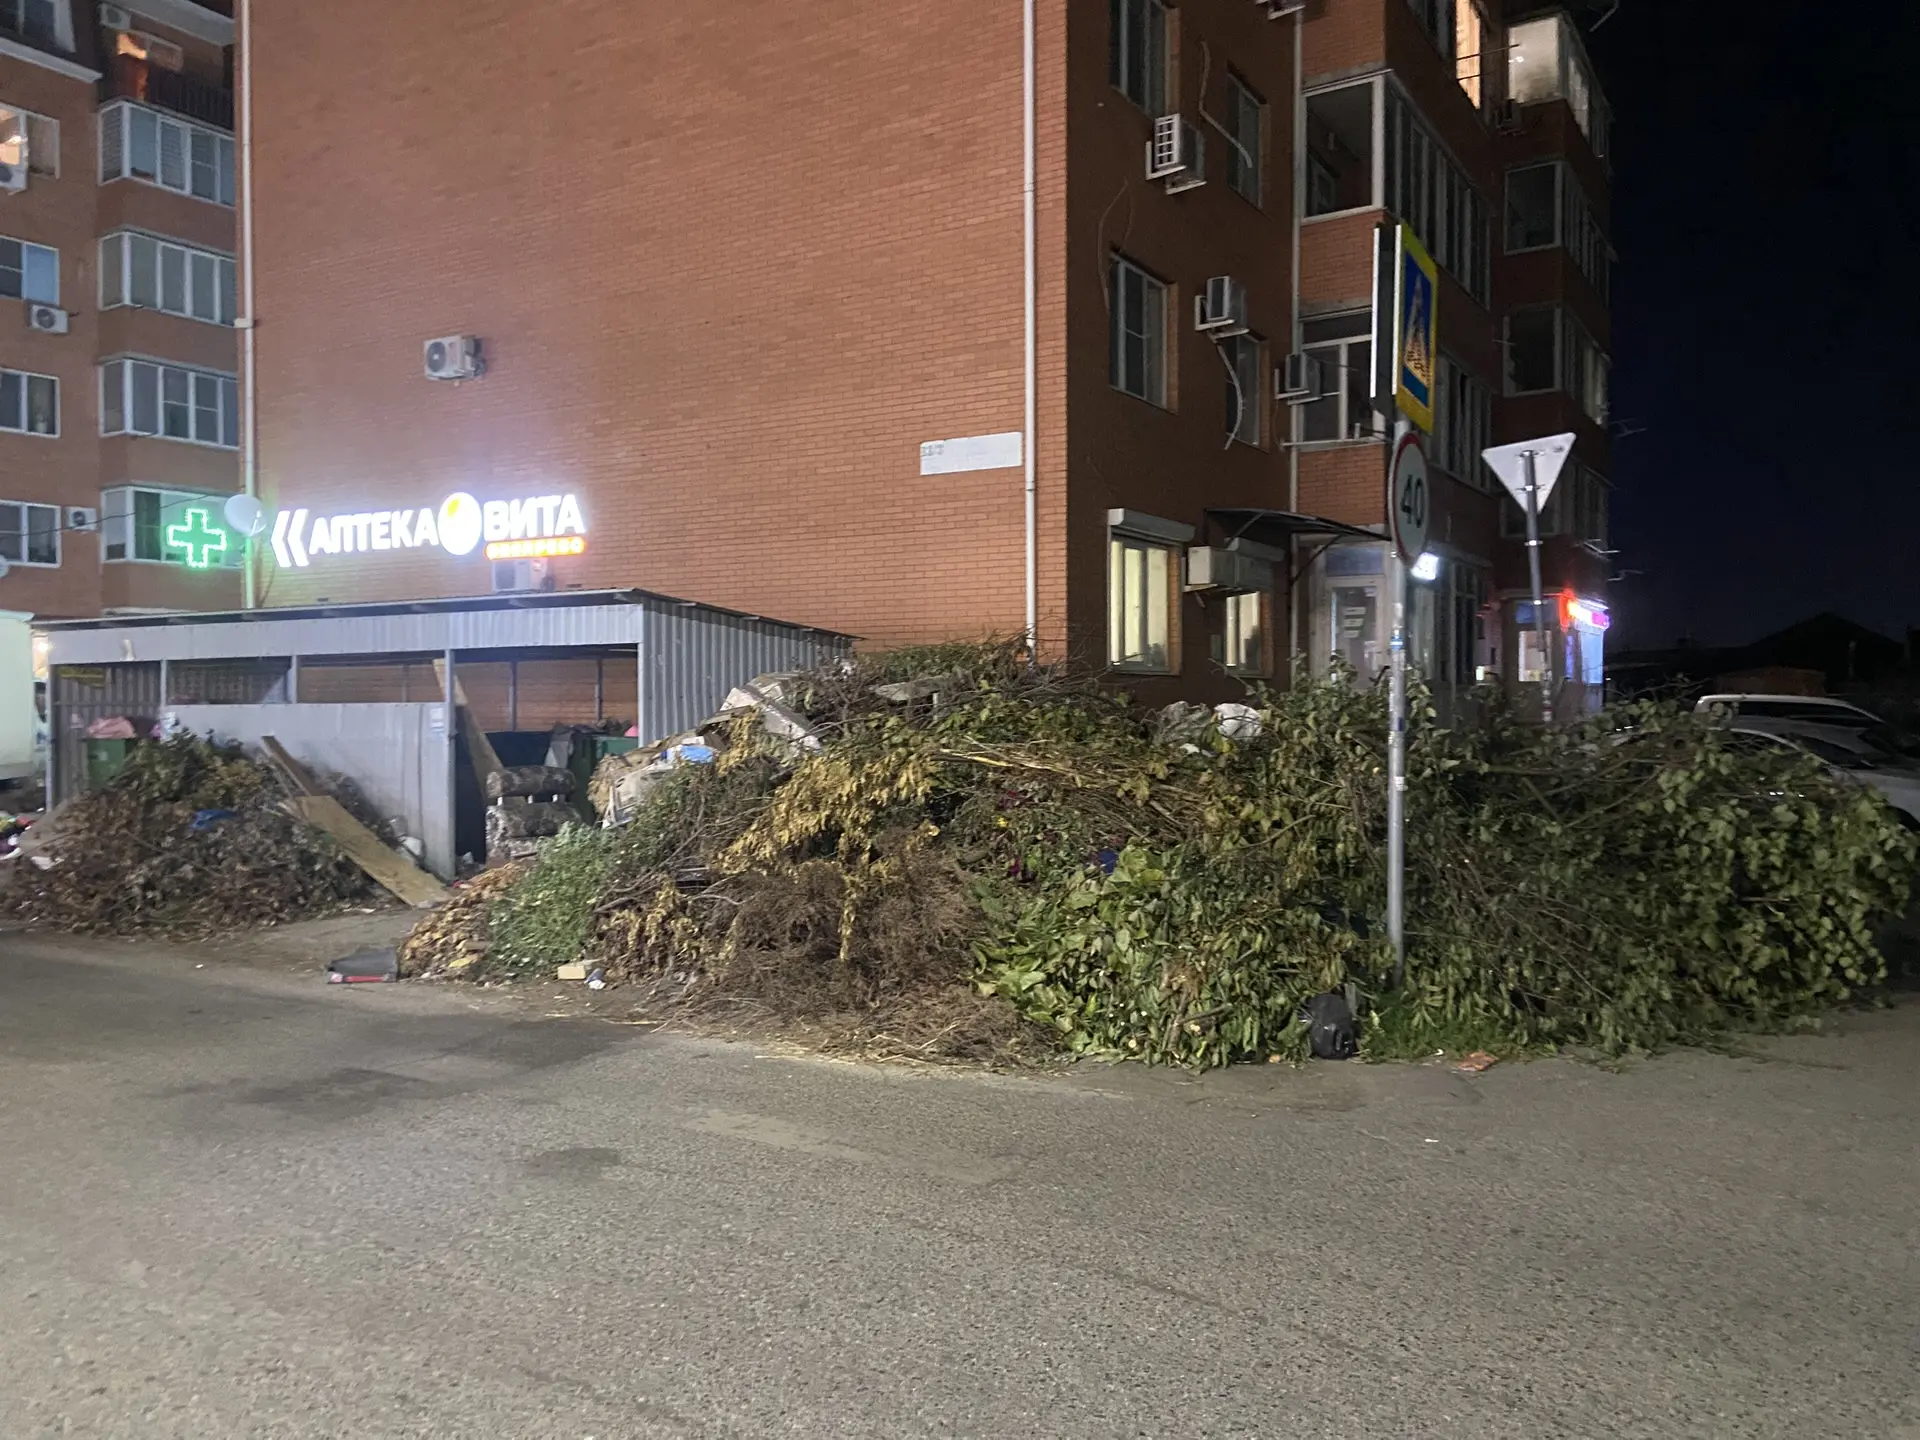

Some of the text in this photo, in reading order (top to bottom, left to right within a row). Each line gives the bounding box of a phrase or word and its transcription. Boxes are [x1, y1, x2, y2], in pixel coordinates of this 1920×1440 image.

[308, 507, 439, 555] АПТЕКА
[483, 494, 586, 541] ВИТА
[1400, 474, 1424, 528] 40
